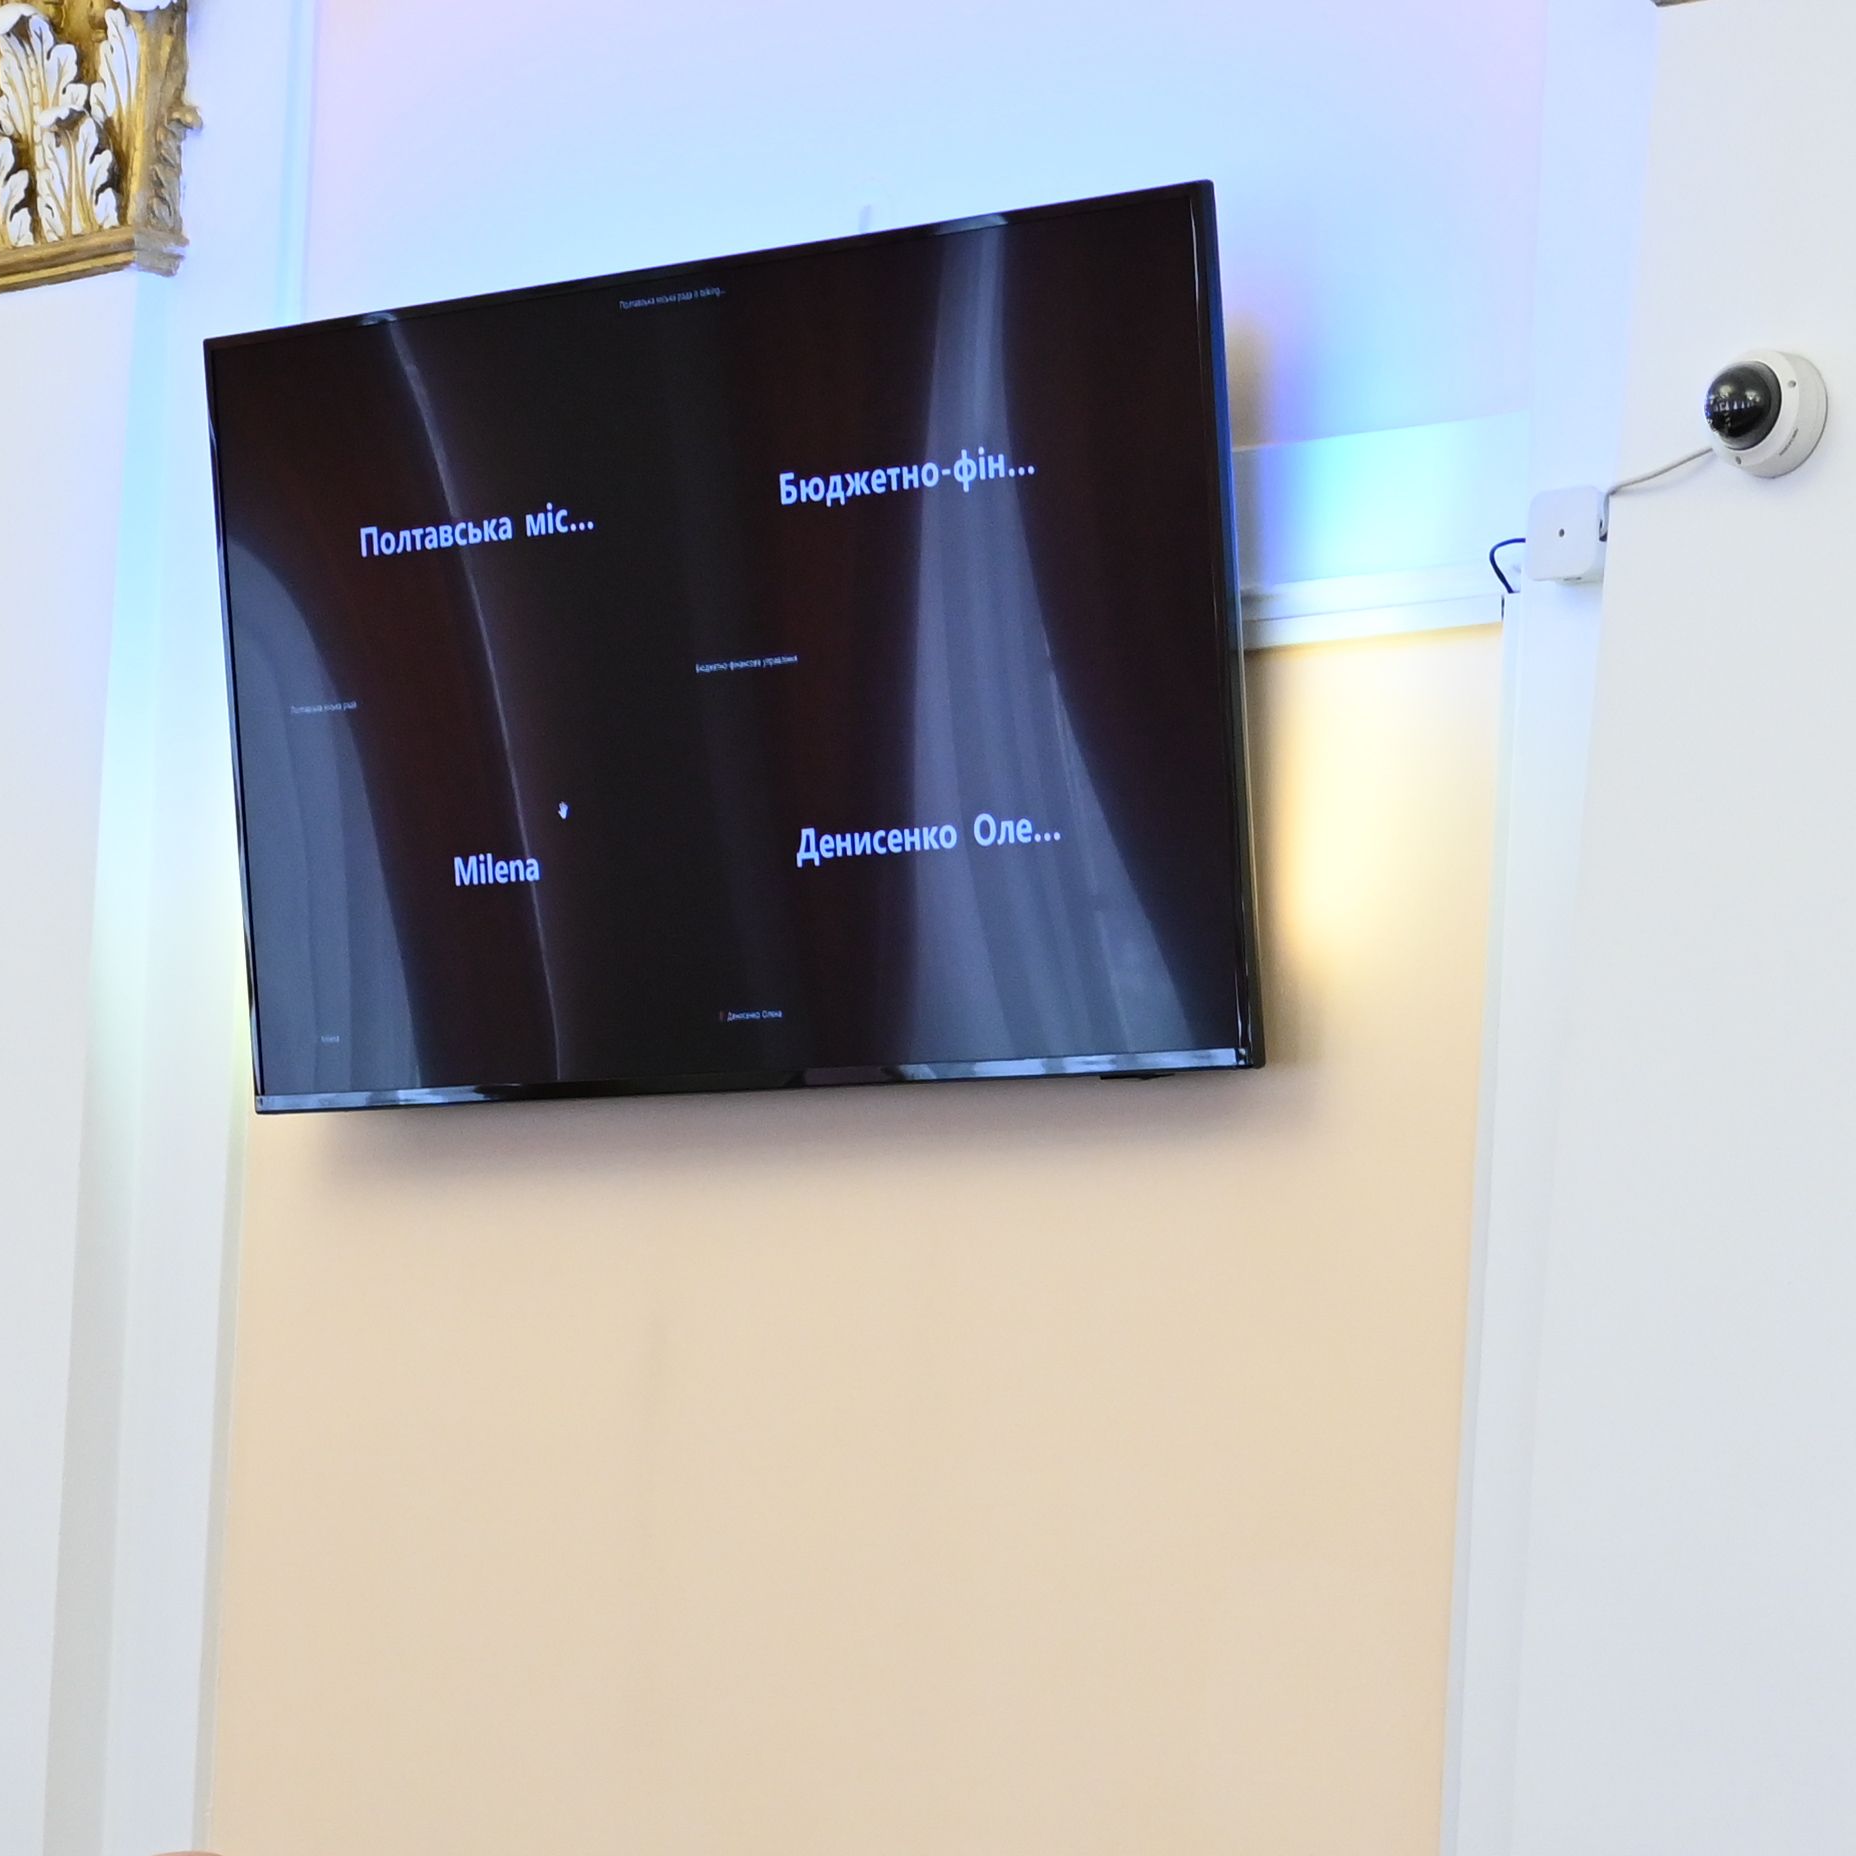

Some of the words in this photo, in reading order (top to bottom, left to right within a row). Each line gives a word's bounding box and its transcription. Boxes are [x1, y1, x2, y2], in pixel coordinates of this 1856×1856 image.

[779, 446, 1035, 508] Бюджетно-фін...
[359, 516, 513, 558] Полтавська
[525, 502, 594, 538] міс...
[796, 824, 958, 868] Денисенко
[973, 813, 1061, 847] Оле...
[454, 853, 540, 887] Milena
